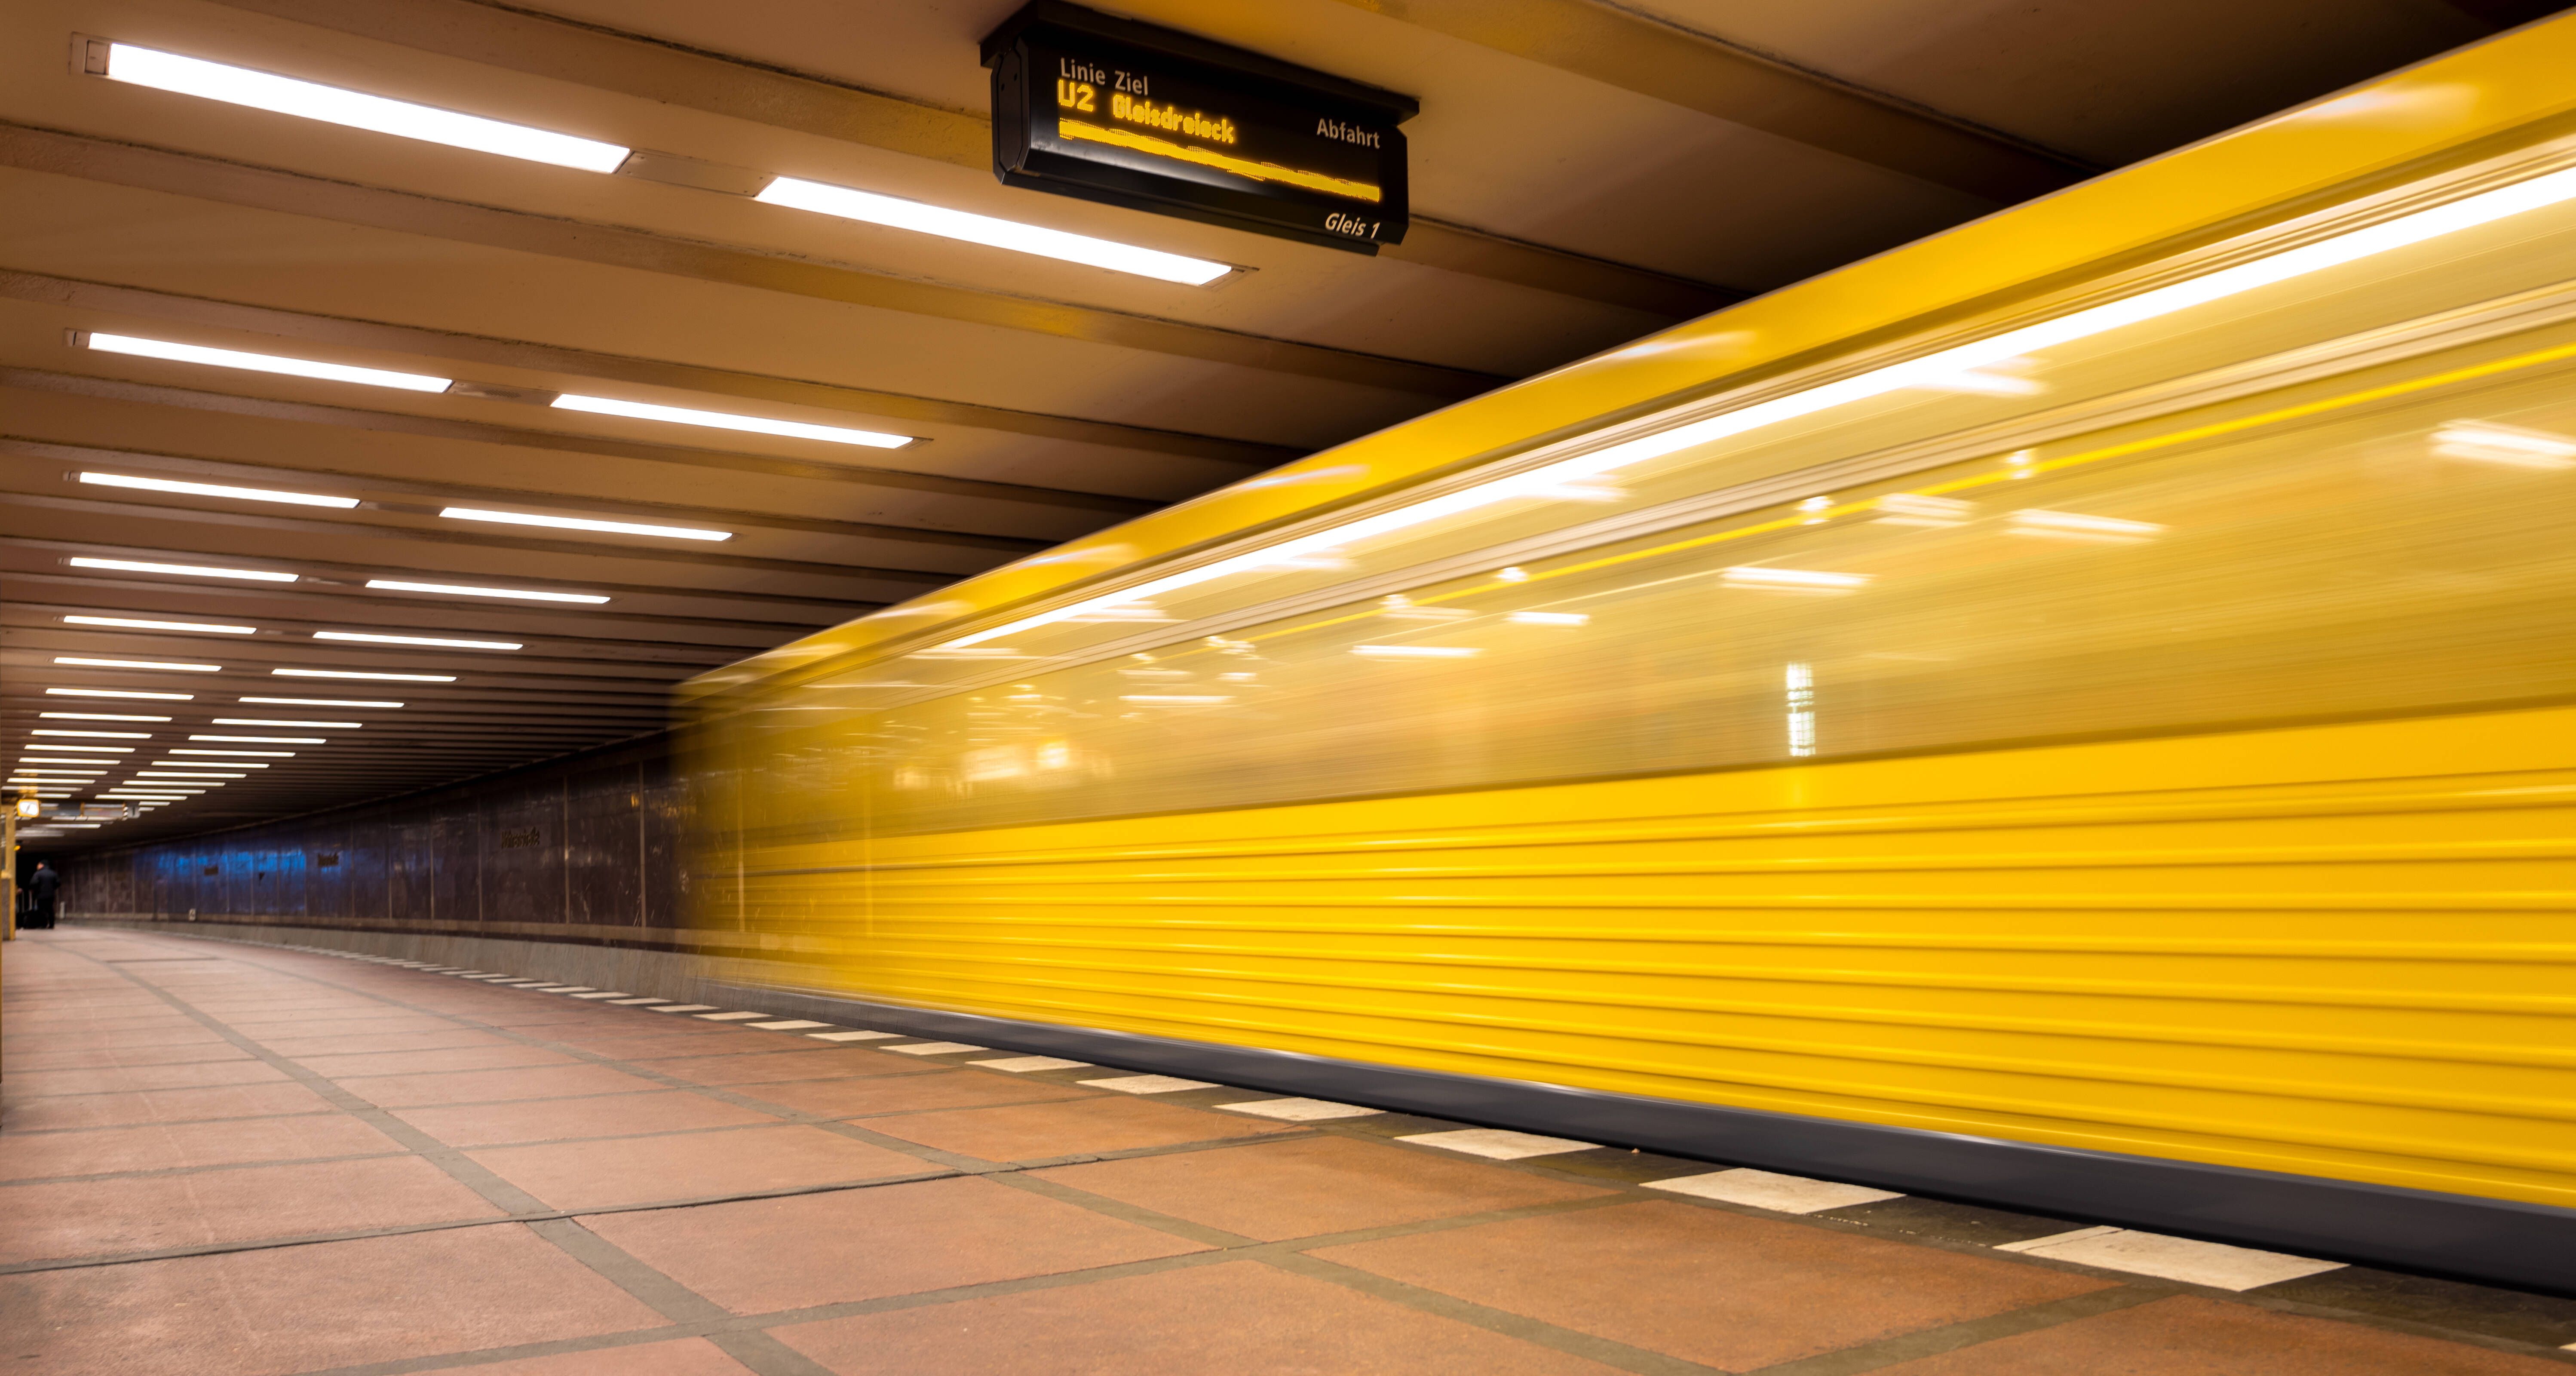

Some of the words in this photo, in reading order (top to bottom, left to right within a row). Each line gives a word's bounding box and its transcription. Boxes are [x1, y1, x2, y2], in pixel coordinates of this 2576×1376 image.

[1061, 57, 1106, 86] Linie
[1114, 70, 1148, 96] Ziel
[1058, 79, 1094, 112] U2
[1113, 94, 1234, 144] Gleisdreieck
[1316, 118, 1380, 149] Abfahrt
[1325, 213, 1367, 237] Gleis
[1371, 222, 1380, 239] 1
